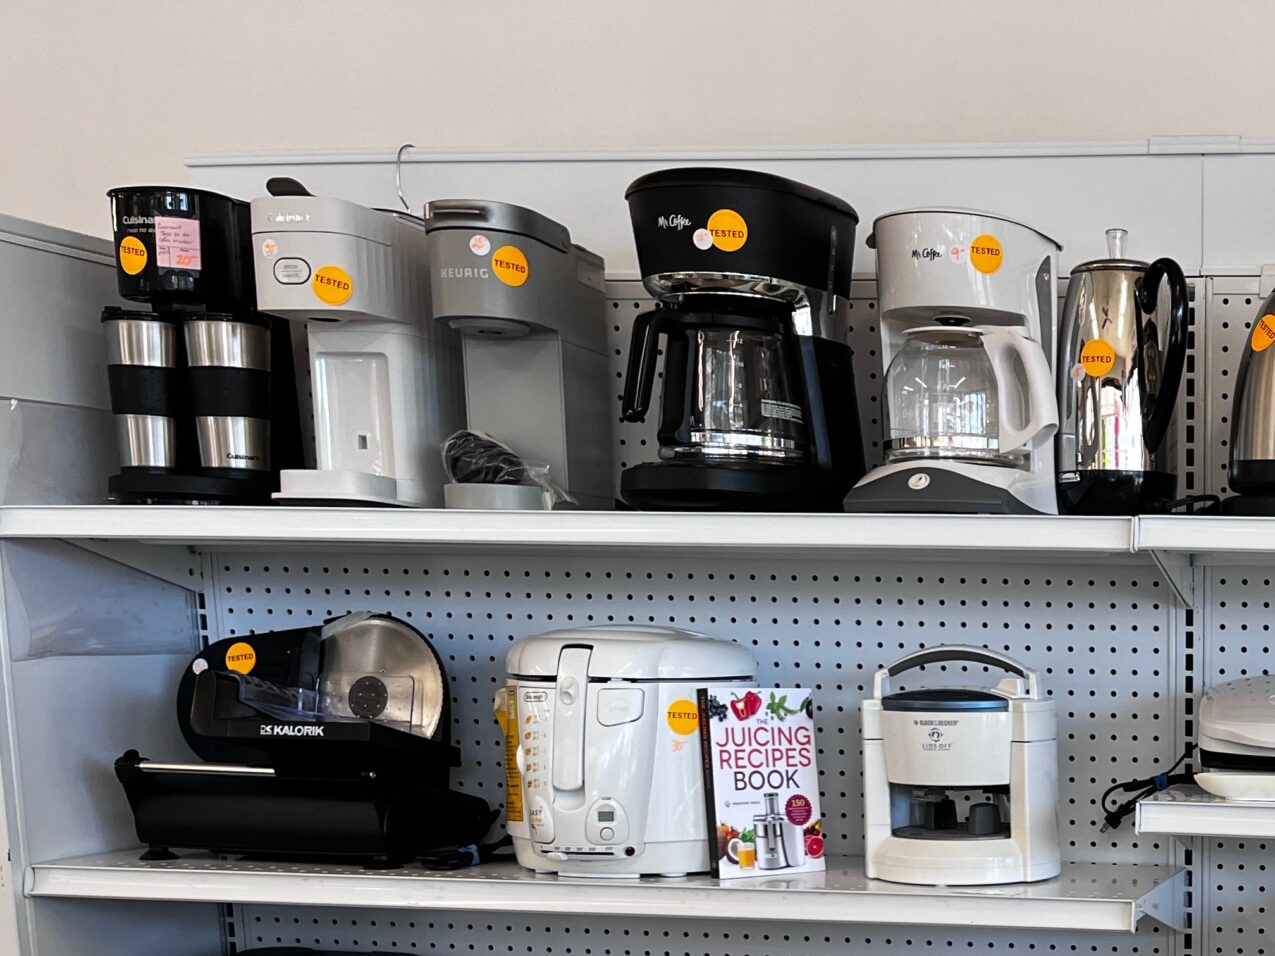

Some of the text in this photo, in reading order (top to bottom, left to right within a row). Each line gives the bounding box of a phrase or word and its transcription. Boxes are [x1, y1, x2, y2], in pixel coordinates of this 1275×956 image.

[122, 216, 155, 225] Cuisina
[669, 214, 692, 231] Coffee
[710, 229, 744, 239] TESTED
[121, 245, 145, 257] TESTED
[922, 247, 942, 261] Coffee
[971, 246, 1001, 256] TESTED
[494, 259, 526, 274] TESTED
[440, 268, 489, 279] KEURIG
[315, 274, 350, 291] TESTED
[1260, 320, 1275, 339] TESTED
[1082, 355, 1112, 364] TESTED
[228, 653, 254, 662] TESTED
[667, 711, 698, 720] TESTED
[273, 726, 324, 736] KALORIK
[716, 726, 812, 748] JUICING
[719, 748, 812, 770] RECIPES
[734, 769, 801, 791] BOOK
